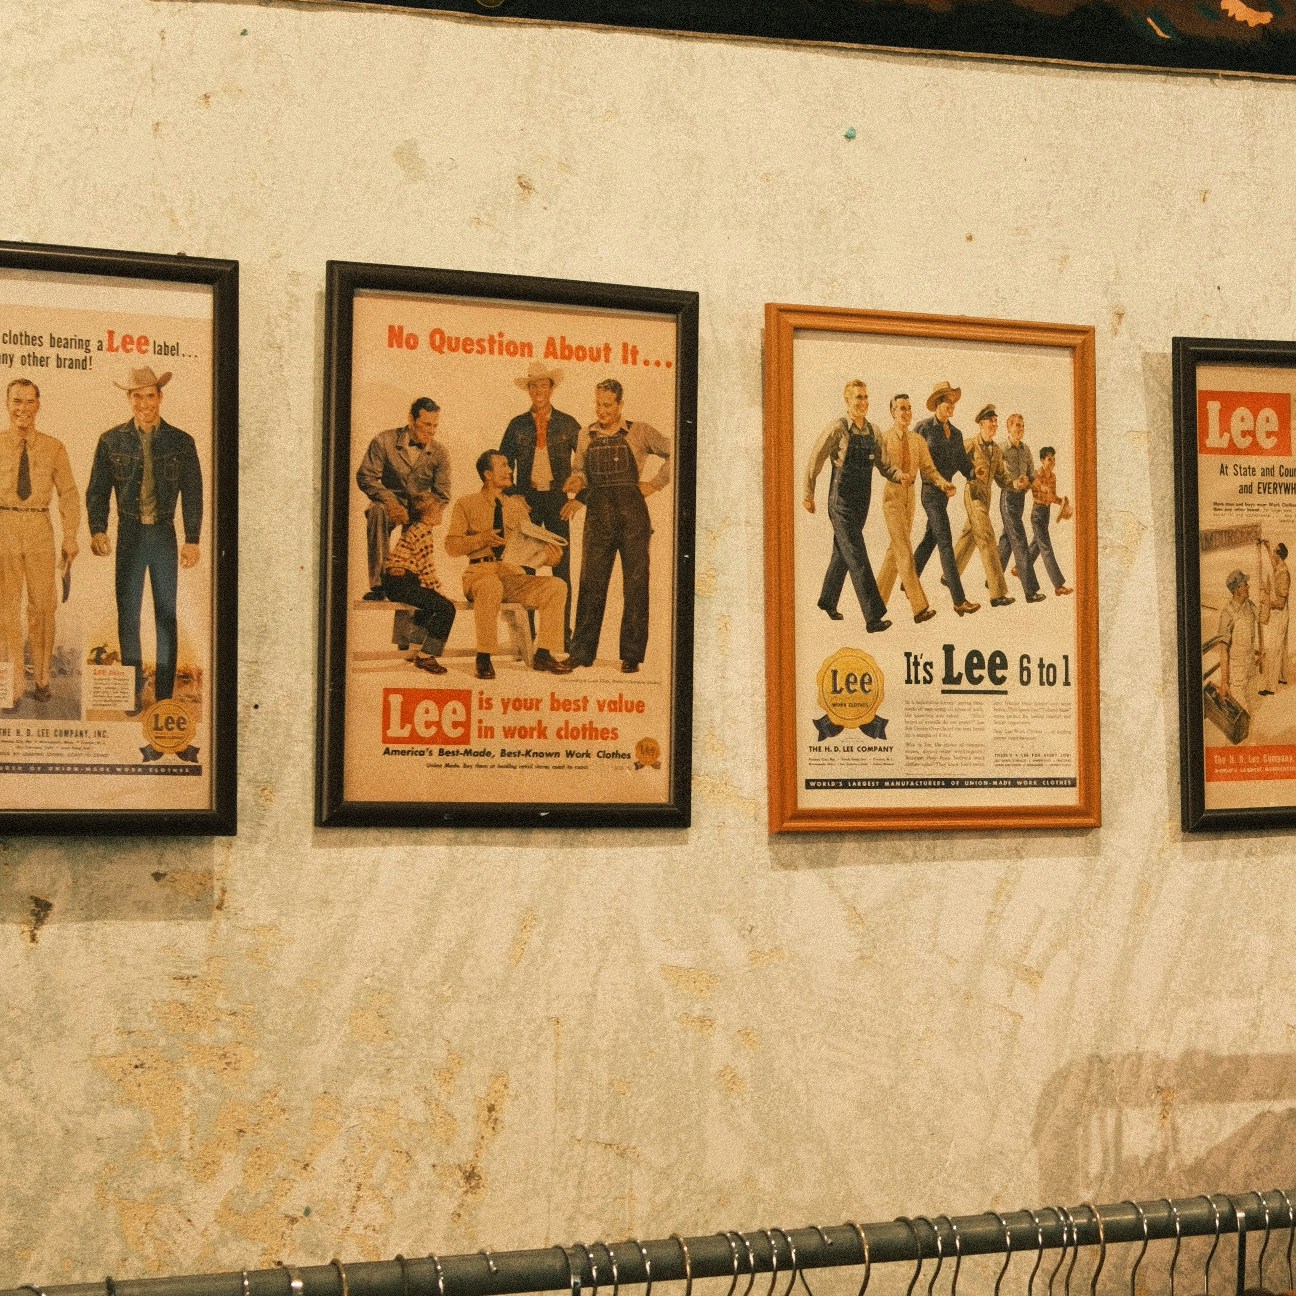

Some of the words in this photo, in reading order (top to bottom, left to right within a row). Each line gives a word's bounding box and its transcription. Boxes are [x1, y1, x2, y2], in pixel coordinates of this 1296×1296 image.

[2, 329, 43, 347] clothes
[50, 333, 91, 353] bearing
[97, 339, 103, 351] a
[105, 329, 150, 354] Lee
[387, 324, 419, 350] No
[429, 327, 533, 357] Question
[543, 336, 612, 363] About
[20, 352, 50, 368] other
[56, 355, 93, 371] brand!
[1205, 400, 1279, 449] Lee
[1219, 463, 1228, 476] At
[1233, 464, 1256, 477] State
[1261, 465, 1275, 477] and
[1238, 482, 1253, 494] and
[904, 652, 933, 684] It's
[942, 644, 1008, 685] Lee
[1019, 654, 1031, 686] 6
[1038, 657, 1057, 686] to
[831, 669, 873, 694] Lee
[478, 691, 493, 711] is
[501, 696, 543, 715] your
[550, 692, 589, 712] best
[596, 694, 646, 714] value
[152, 713, 188, 732] Lee
[386, 693, 467, 738] Lee
[477, 719, 495, 739] in
[502, 720, 548, 740] work
[556, 721, 619, 741] clothes
[383, 747, 433, 757] America's
[500, 749, 560, 758] Best-Known
[566, 749, 592, 759] Work
[596, 750, 632, 759] Clothes
